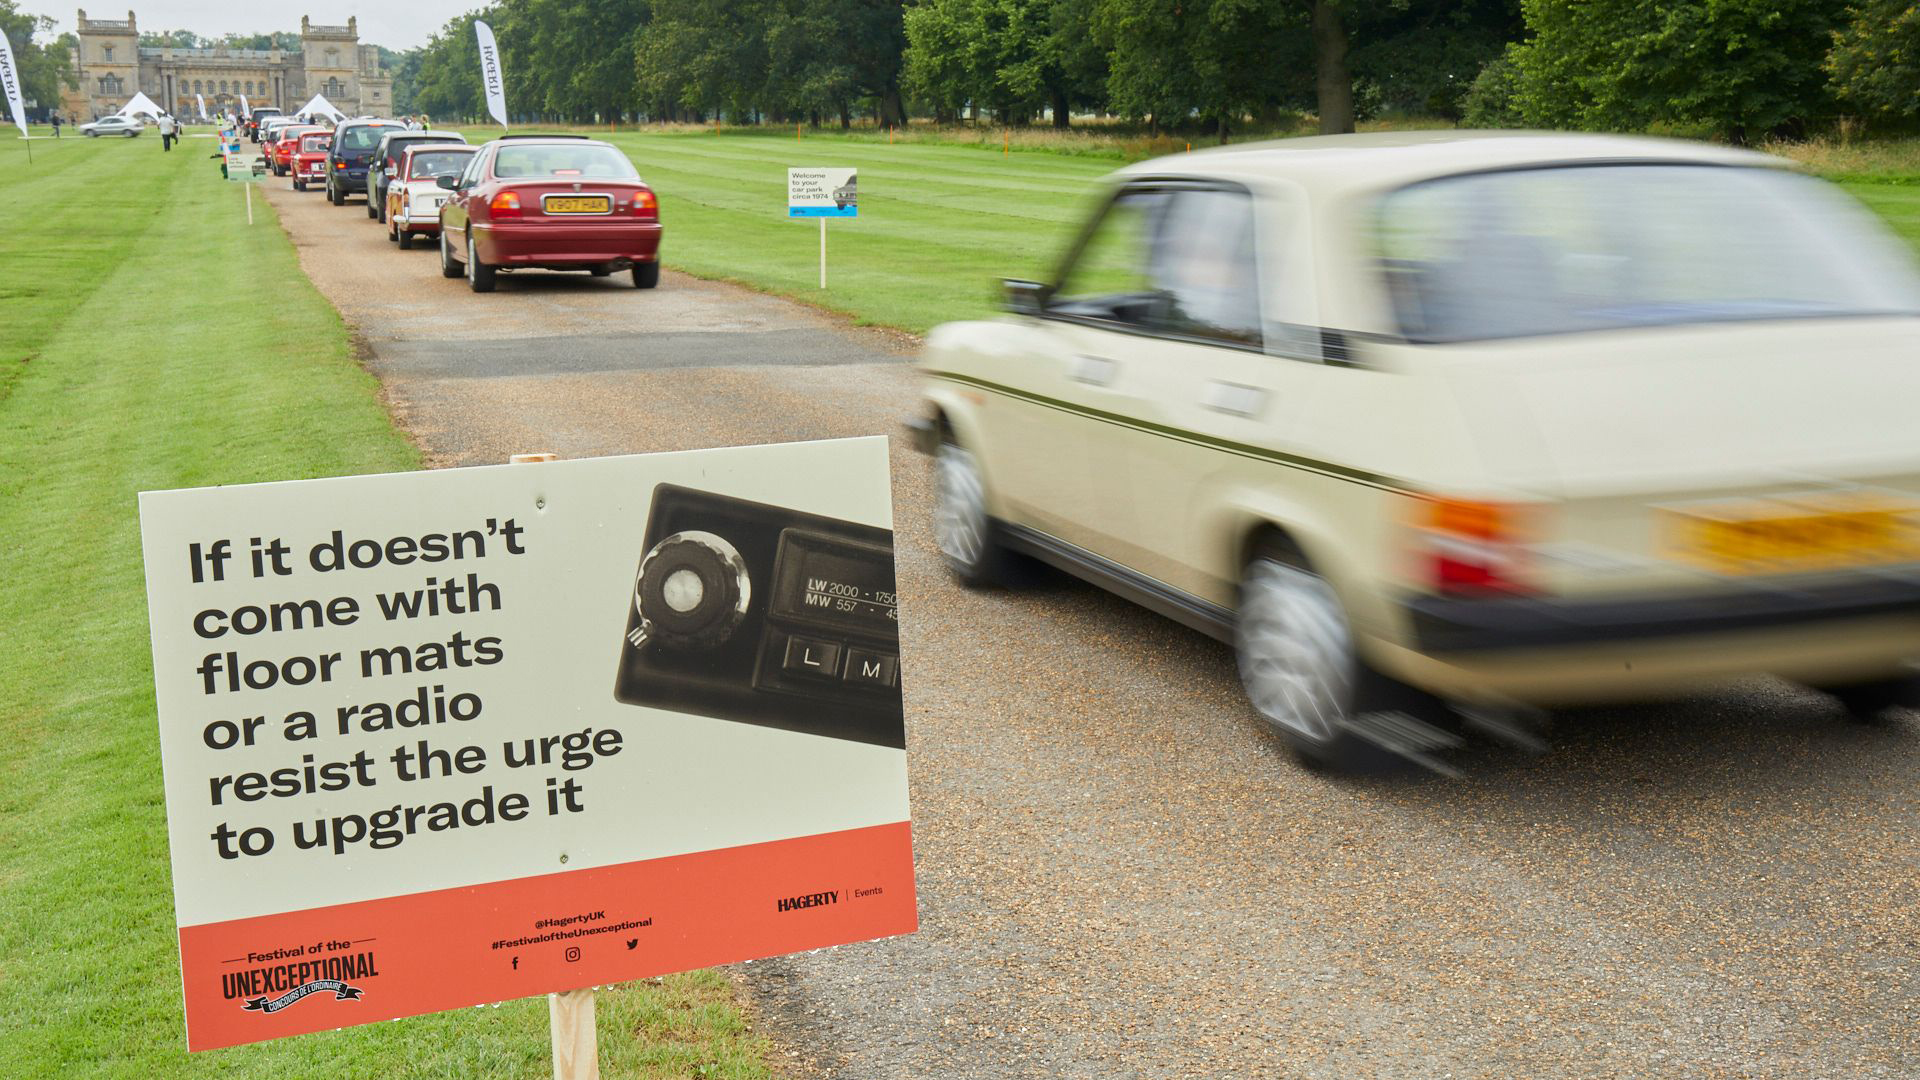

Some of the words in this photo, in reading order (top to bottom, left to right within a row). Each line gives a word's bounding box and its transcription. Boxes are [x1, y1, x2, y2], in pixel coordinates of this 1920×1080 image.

[189, 539, 232, 583] If
[250, 537, 293, 578] it
[308, 518, 526, 572] doesn’t
[805, 592, 831, 608] MW
[836, 600, 858, 612] 557
[808, 578, 827, 591] LW
[829, 583, 859, 597] 2000
[193, 595, 360, 639] come
[376, 573, 502, 621] with
[196, 651, 341, 694] floor
[360, 631, 504, 678] mats
[804, 648, 820, 665] L
[862, 660, 881, 678] M
[202, 715, 265, 750] or
[283, 710, 318, 742] a
[337, 684, 483, 736] radio
[209, 749, 377, 806] resist
[389, 740, 487, 782] the
[503, 726, 624, 771] urge
[210, 821, 275, 860] to
[292, 785, 530, 855] upgrade
[546, 777, 585, 815] it
[777, 890, 839, 913] HAGERTY
[855, 887, 883, 898] Events
[491, 917, 653, 950] #FestivaloftheUnexceptional
[535, 911, 605, 930] @HagertyUK
[247, 945, 304, 963] Festival
[308, 942, 323, 954] of
[326, 940, 351, 951] the
[222, 951, 379, 1000] UNEXCEPTIONAL
[268, 990, 300, 1012] CONCOURS
[300, 987, 307, 997] DE
